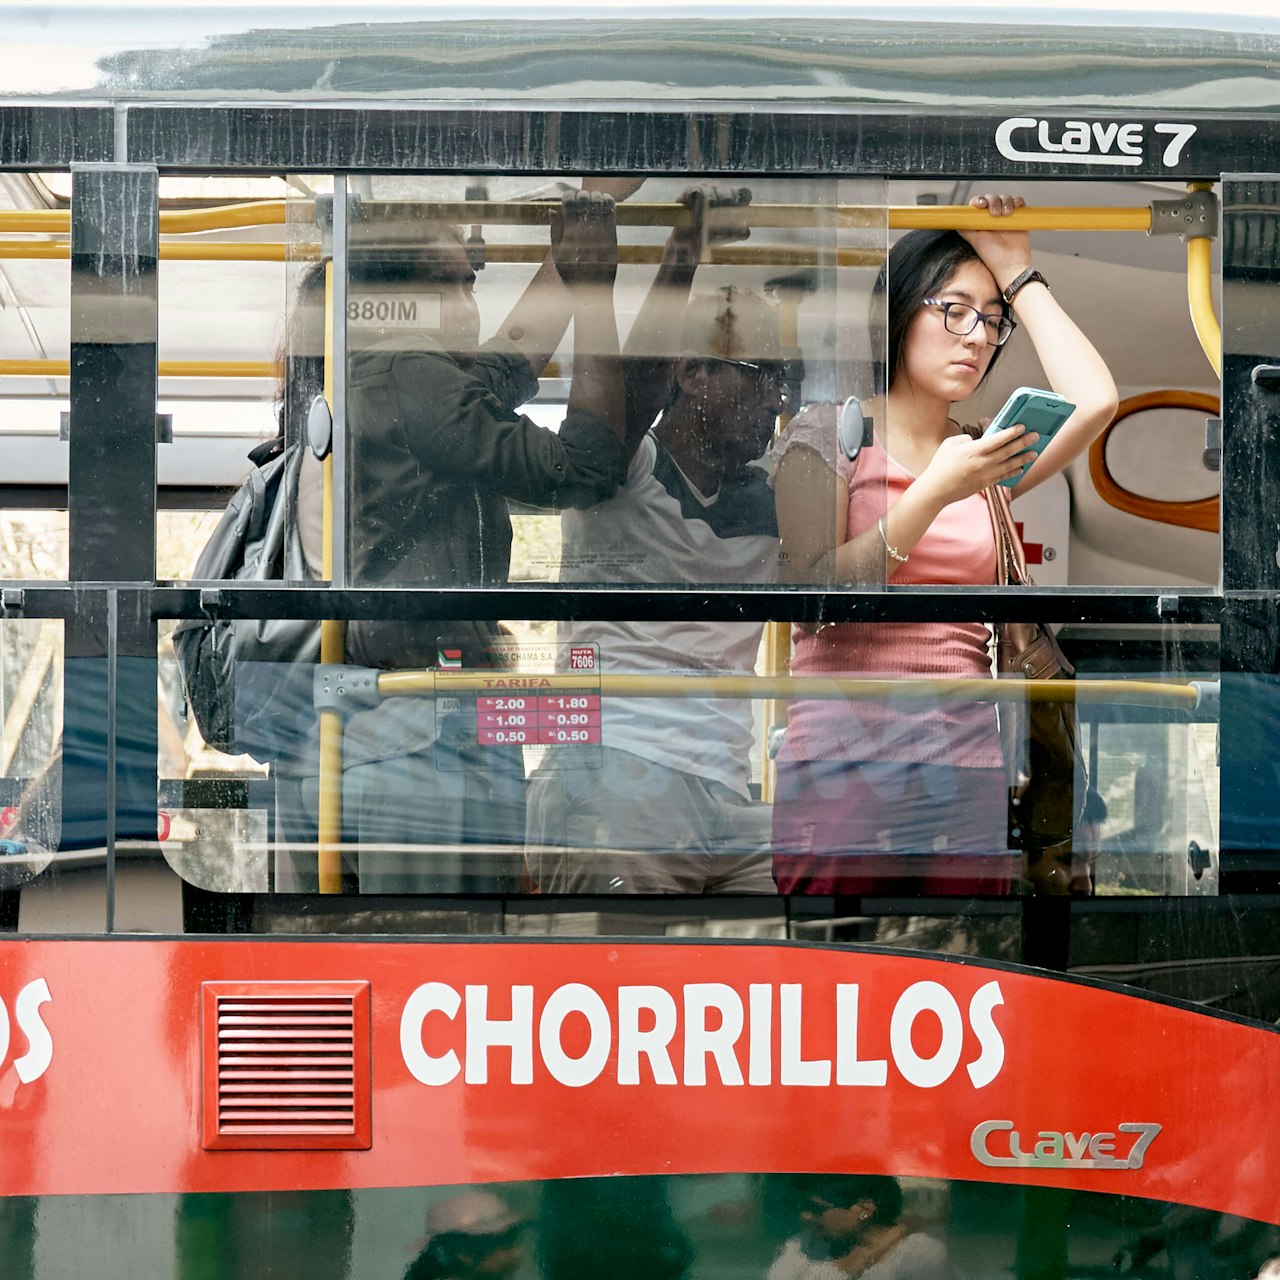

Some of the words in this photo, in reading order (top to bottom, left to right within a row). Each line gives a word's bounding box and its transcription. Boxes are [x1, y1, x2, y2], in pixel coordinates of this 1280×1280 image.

[1154, 123, 1198, 168] 7
[510, 652, 539, 662] CHAMA
[571, 655, 594, 669] 7606
[483, 678, 551, 689] TARIFA
[495, 699, 526, 710] 2.00
[557, 698, 589, 708] 1.80
[496, 715, 526, 726] 1.00
[556, 714, 589, 725] 0.90
[495, 731, 527, 742] 0.50
[557, 730, 589, 741] 0.50
[399, 980, 1006, 1089] CHORRILLOS
